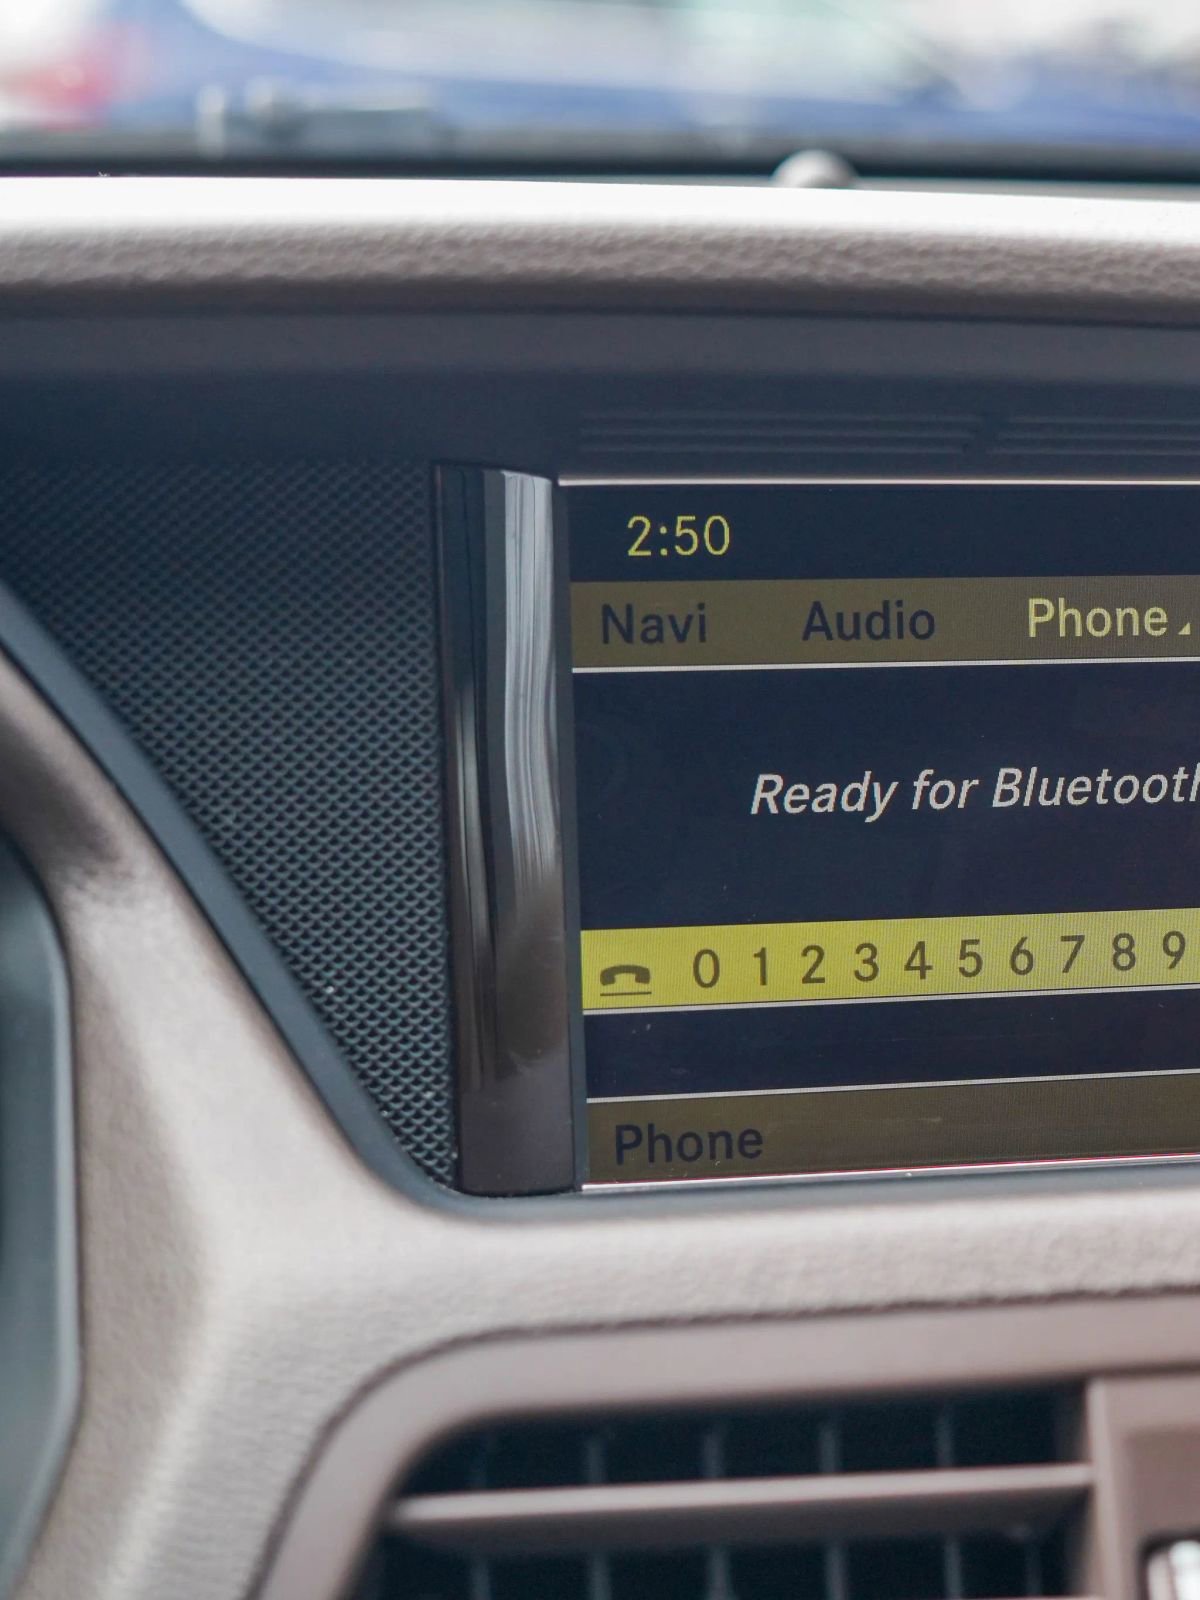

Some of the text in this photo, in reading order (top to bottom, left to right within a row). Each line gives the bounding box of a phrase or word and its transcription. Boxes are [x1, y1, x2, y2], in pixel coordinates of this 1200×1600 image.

[628, 515, 731, 557] 2:50
[602, 603, 708, 645] Navi
[802, 600, 936, 642] Audio
[1028, 597, 1169, 638] Phone
[750, 770, 899, 824] Ready
[911, 768, 980, 811] for
[692, 948, 721, 988] 0
[752, 946, 769, 986] 1
[801, 944, 826, 985] 2
[853, 942, 880, 983] 3
[903, 940, 934, 980] 4
[958, 938, 984, 978] 5
[1010, 936, 1035, 976] 6
[1060, 934, 1086, 974] 7
[1111, 932, 1137, 972] 8
[1162, 930, 1187, 970] 9
[614, 1123, 764, 1166] Phone
